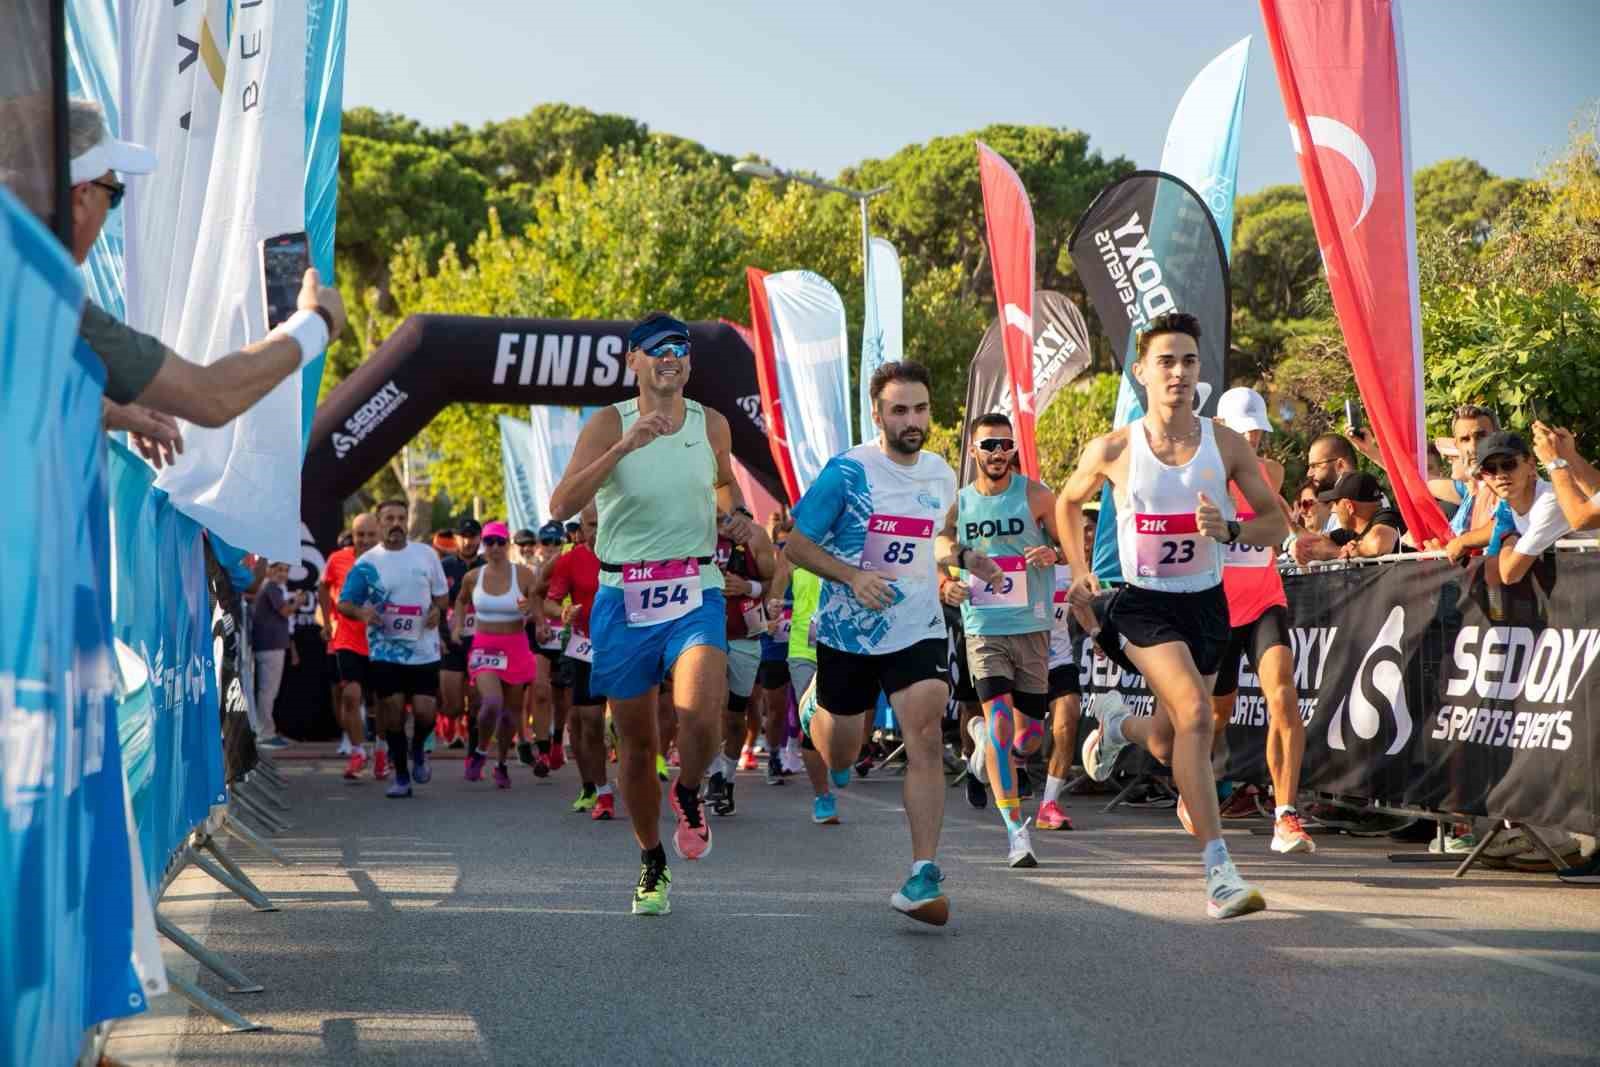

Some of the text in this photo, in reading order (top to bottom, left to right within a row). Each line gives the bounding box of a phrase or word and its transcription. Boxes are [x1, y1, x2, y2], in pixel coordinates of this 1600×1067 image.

[493, 332, 640, 386] FINIS
[873, 519, 899, 533] 21K
[965, 518, 1025, 540] BOLD
[1140, 519, 1169, 532] 21K
[883, 541, 917, 565] 85
[1158, 539, 1196, 565] 23
[628, 567, 653, 580] 21K
[640, 583, 689, 610] 154
[392, 618, 413, 632] 68
[1446, 626, 1600, 704] SEDOXY
[1431, 705, 1514, 748] SPORTS
